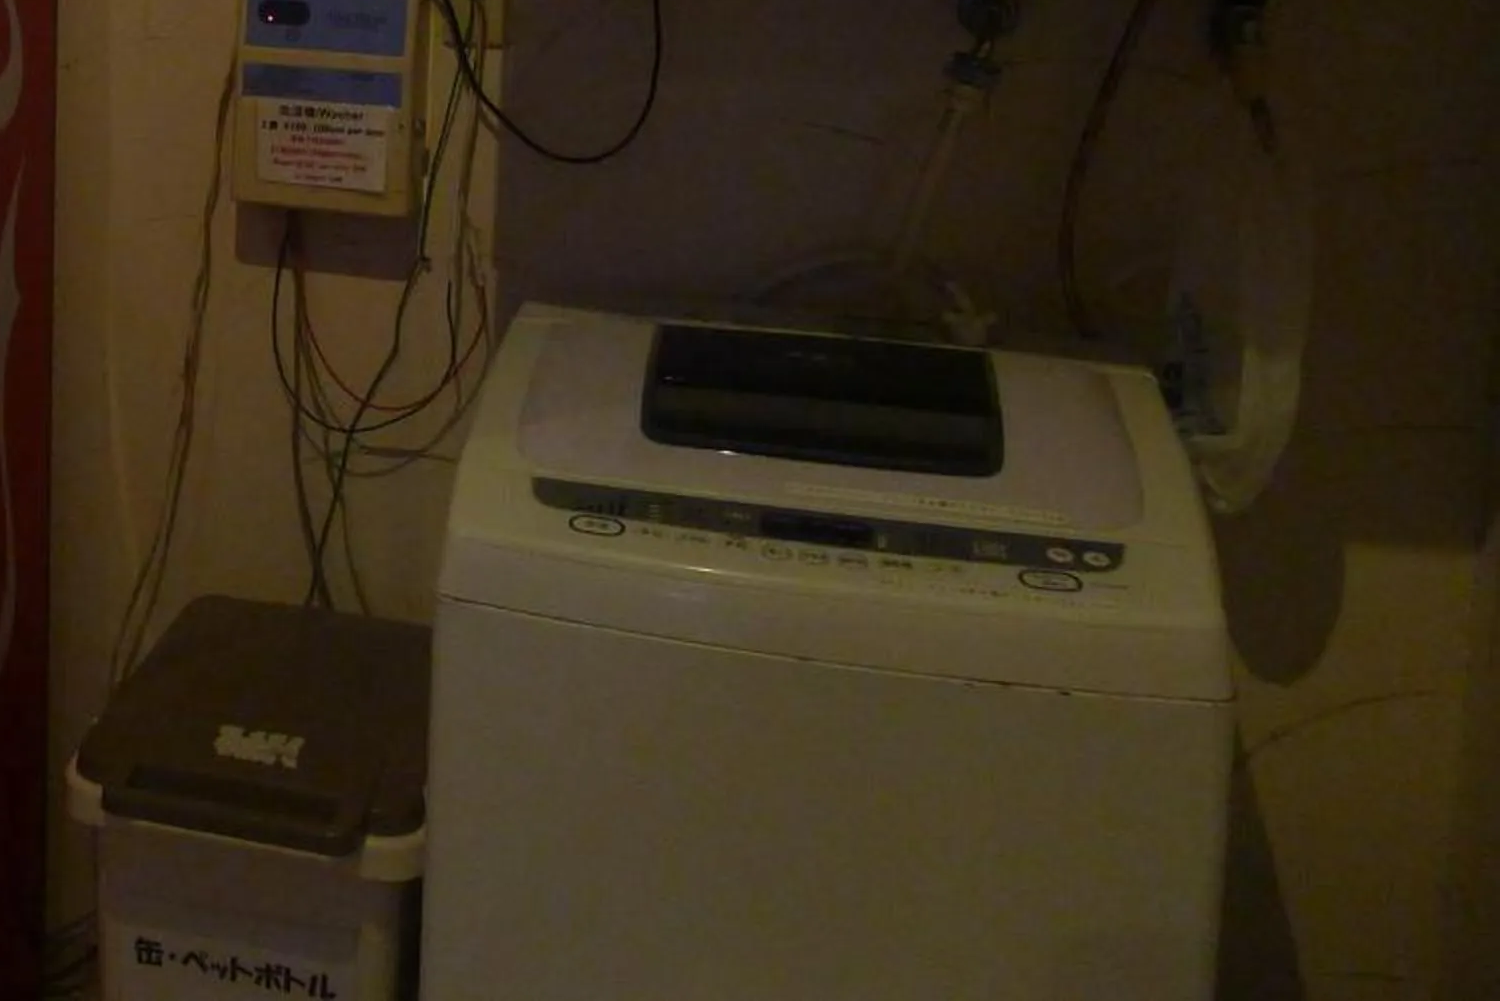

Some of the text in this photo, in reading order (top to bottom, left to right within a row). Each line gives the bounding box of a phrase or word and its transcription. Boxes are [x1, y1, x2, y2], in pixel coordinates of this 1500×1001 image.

[134, 935, 337, 1000] 缶・ペットボトル
